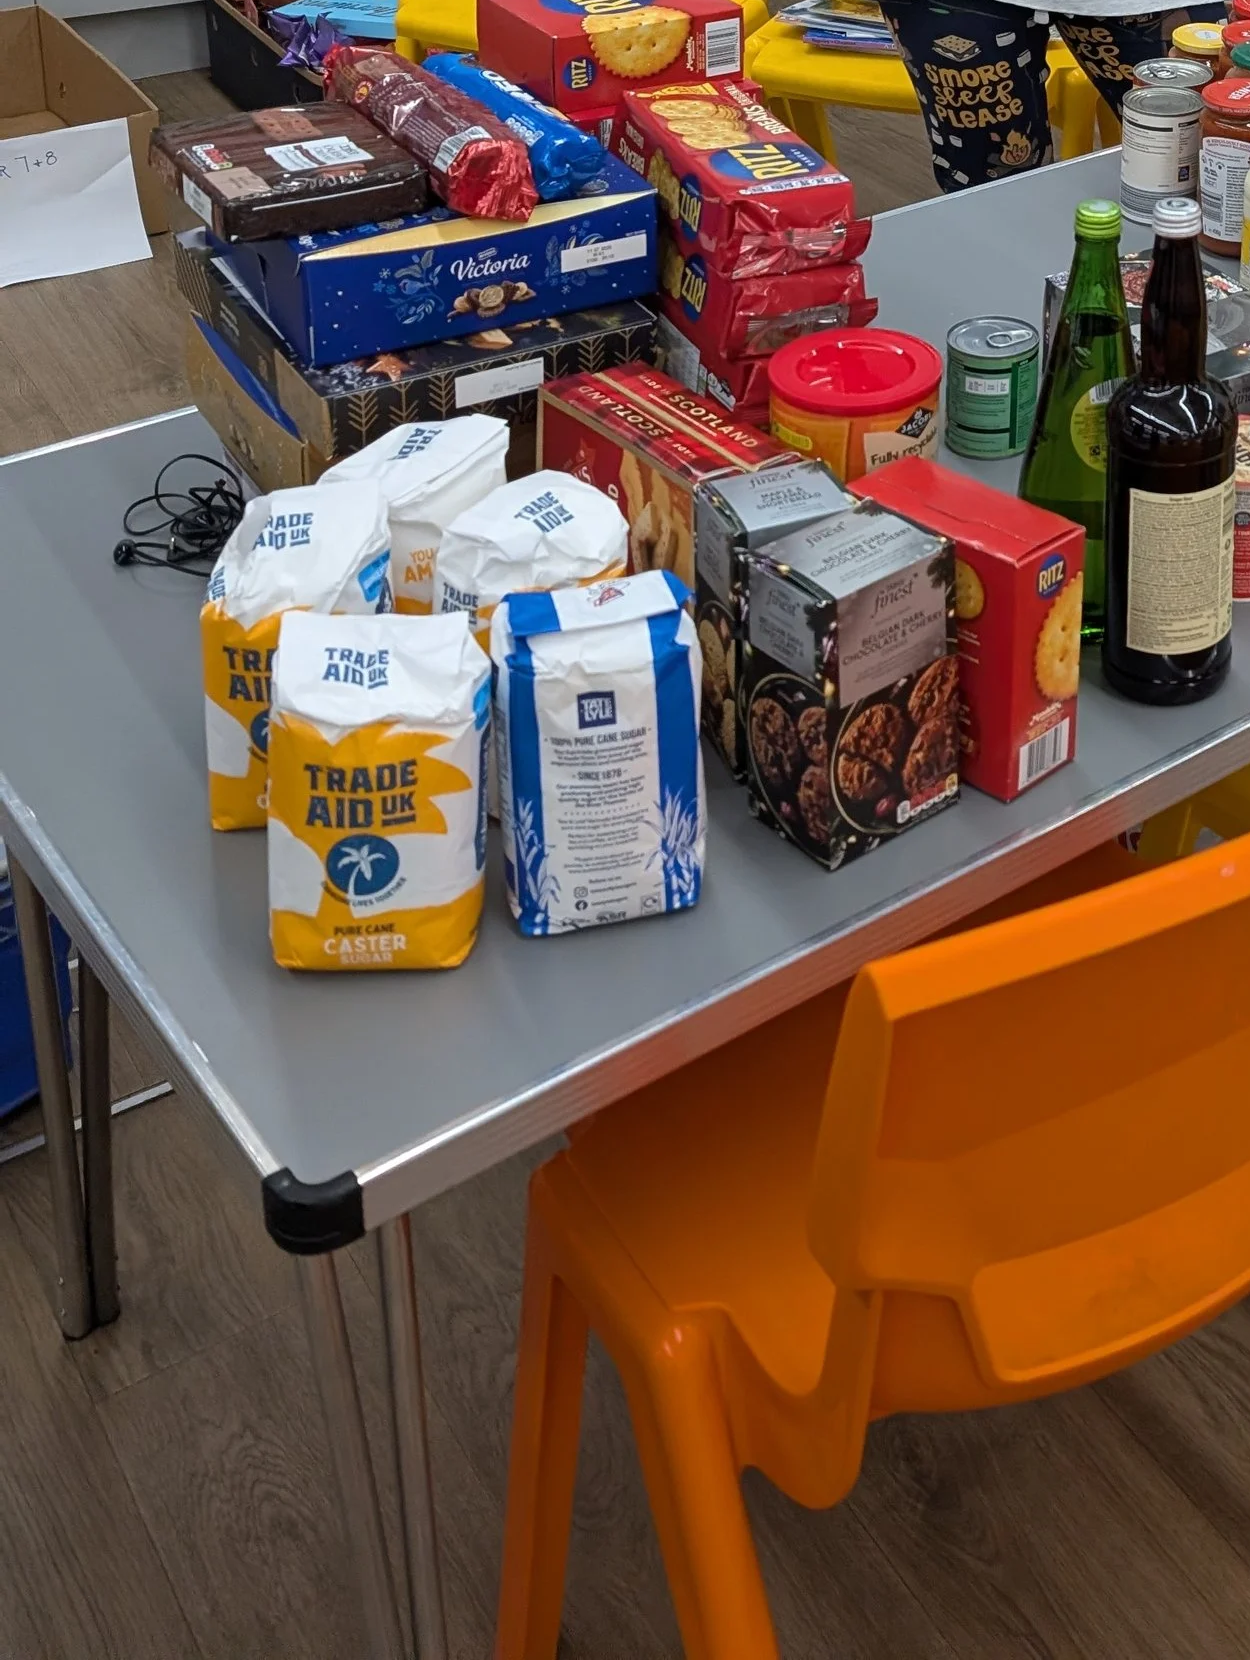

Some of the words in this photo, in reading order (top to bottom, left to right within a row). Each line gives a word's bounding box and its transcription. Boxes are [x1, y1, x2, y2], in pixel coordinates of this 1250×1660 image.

[570, 58, 589, 90] RITZ
[743, 104, 789, 136] BREAKS
[17, 150, 58, 175] 7+8
[618, 137, 645, 175] BREAKS
[726, 143, 811, 181] RITZ
[679, 187, 702, 234] RITZ
[450, 253, 532, 281] Victoria
[683, 270, 708, 314] RITZ
[578, 384, 665, 438] SCOTLAND
[638, 373, 662, 391] MADE
[669, 393, 759, 449] SCOTLAND
[672, 442, 698, 460] MADE
[871, 450, 899, 466] Fully
[748, 471, 793, 489] finest
[514, 491, 560, 521] TRADE
[532, 510, 560, 533] AID
[558, 504, 571, 518] UK
[264, 512, 314, 530] RADE
[805, 521, 846, 548] finest
[252, 532, 286, 552] AID
[290, 527, 311, 541] UK
[1039, 561, 1065, 592] RITZ
[443, 582, 478, 609] TRADE
[871, 580, 914, 619] finest
[842, 633, 898, 666] CHOCOLATE
[908, 610, 943, 633] CHERRY
[861, 622, 900, 648] BELGIAN
[902, 610, 925, 627] DARK
[324, 646, 390, 669] TRADE
[322, 661, 364, 687] AID
[367, 666, 389, 683] UK
[574, 735, 595, 747] PURE
[597, 732, 618, 745] CANE
[620, 726, 647, 741] SUGAR
[303, 758, 419, 794] TRADE
[577, 771, 600, 782] SINCE
[305, 795, 374, 829] AID
[381, 790, 417, 816] UK
[323, 933, 408, 954] CASTER
[333, 924, 363, 937] PURE
[365, 922, 396, 936] CANE
[339, 951, 394, 965] SUGAR
